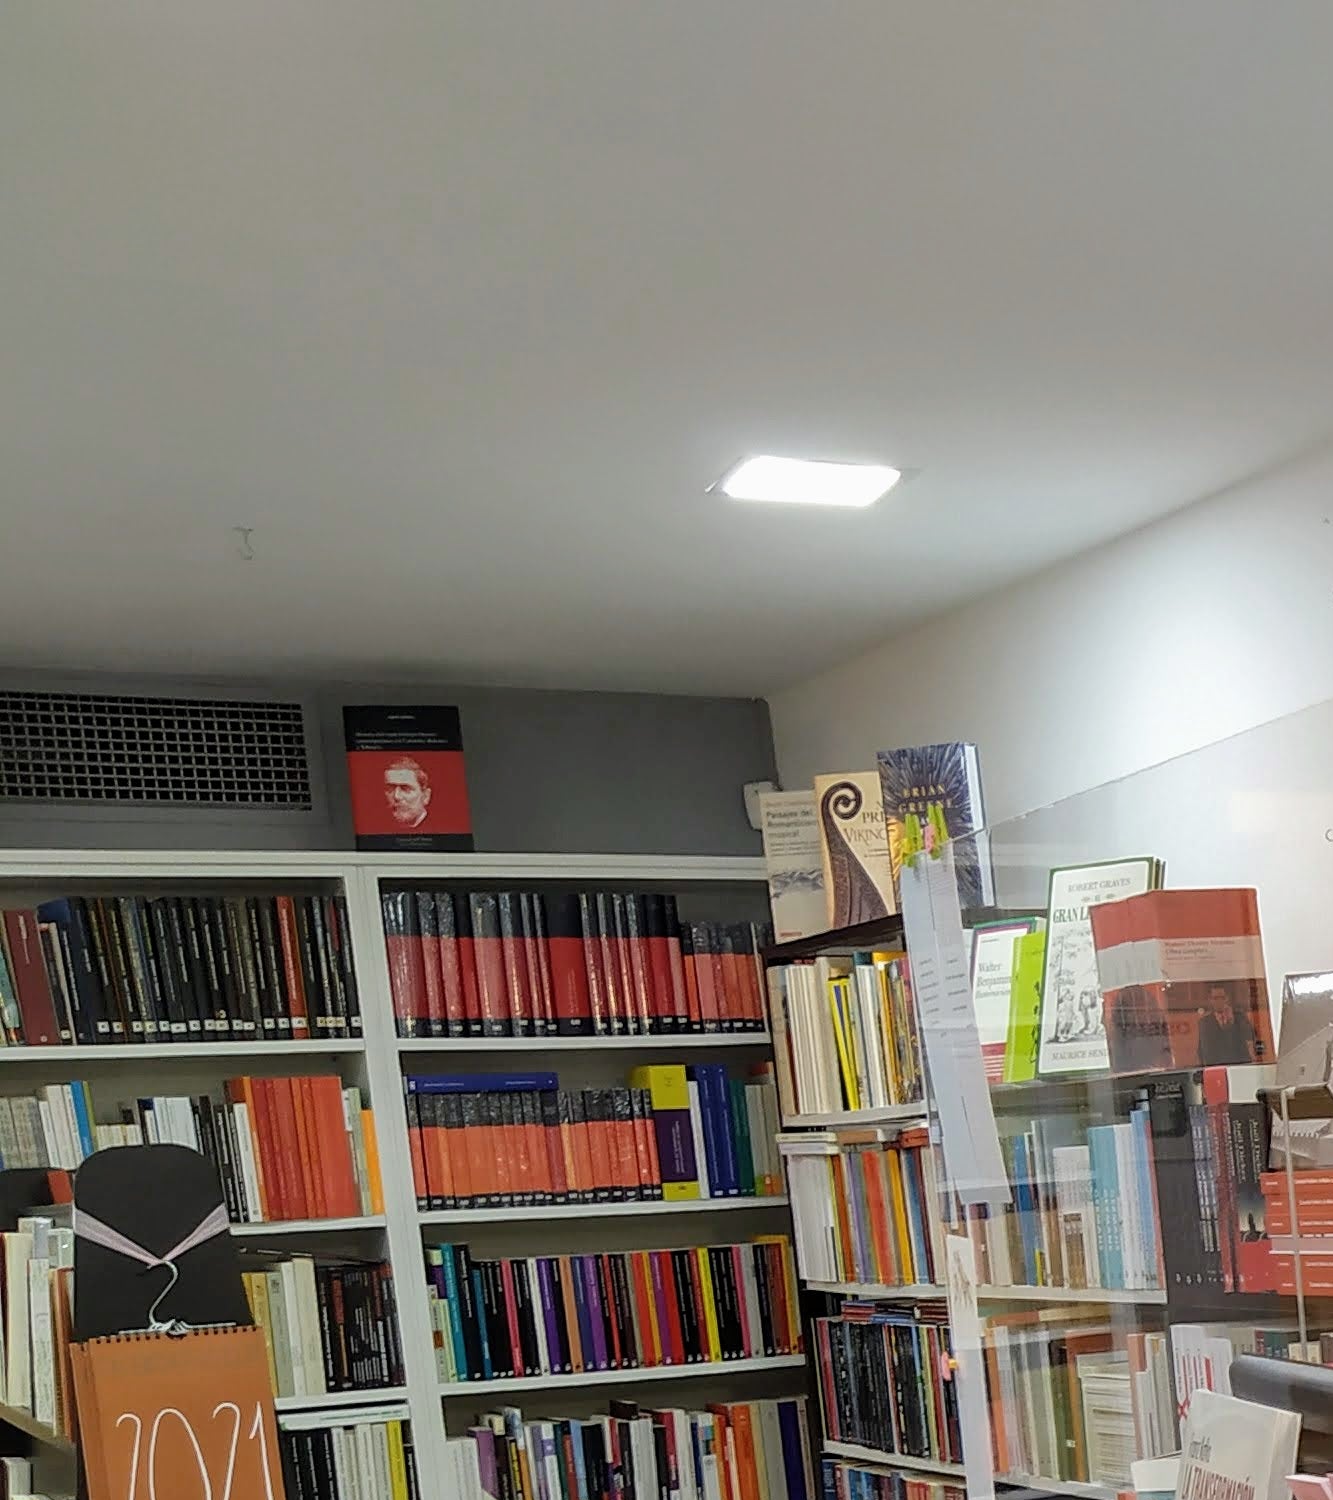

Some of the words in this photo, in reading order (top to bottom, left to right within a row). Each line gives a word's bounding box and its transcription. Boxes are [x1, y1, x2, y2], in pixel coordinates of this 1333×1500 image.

[903, 783, 946, 798] BRIAN
[1099, 876, 1131, 890] GRAVES
[1053, 906, 1078, 925] GRAN
